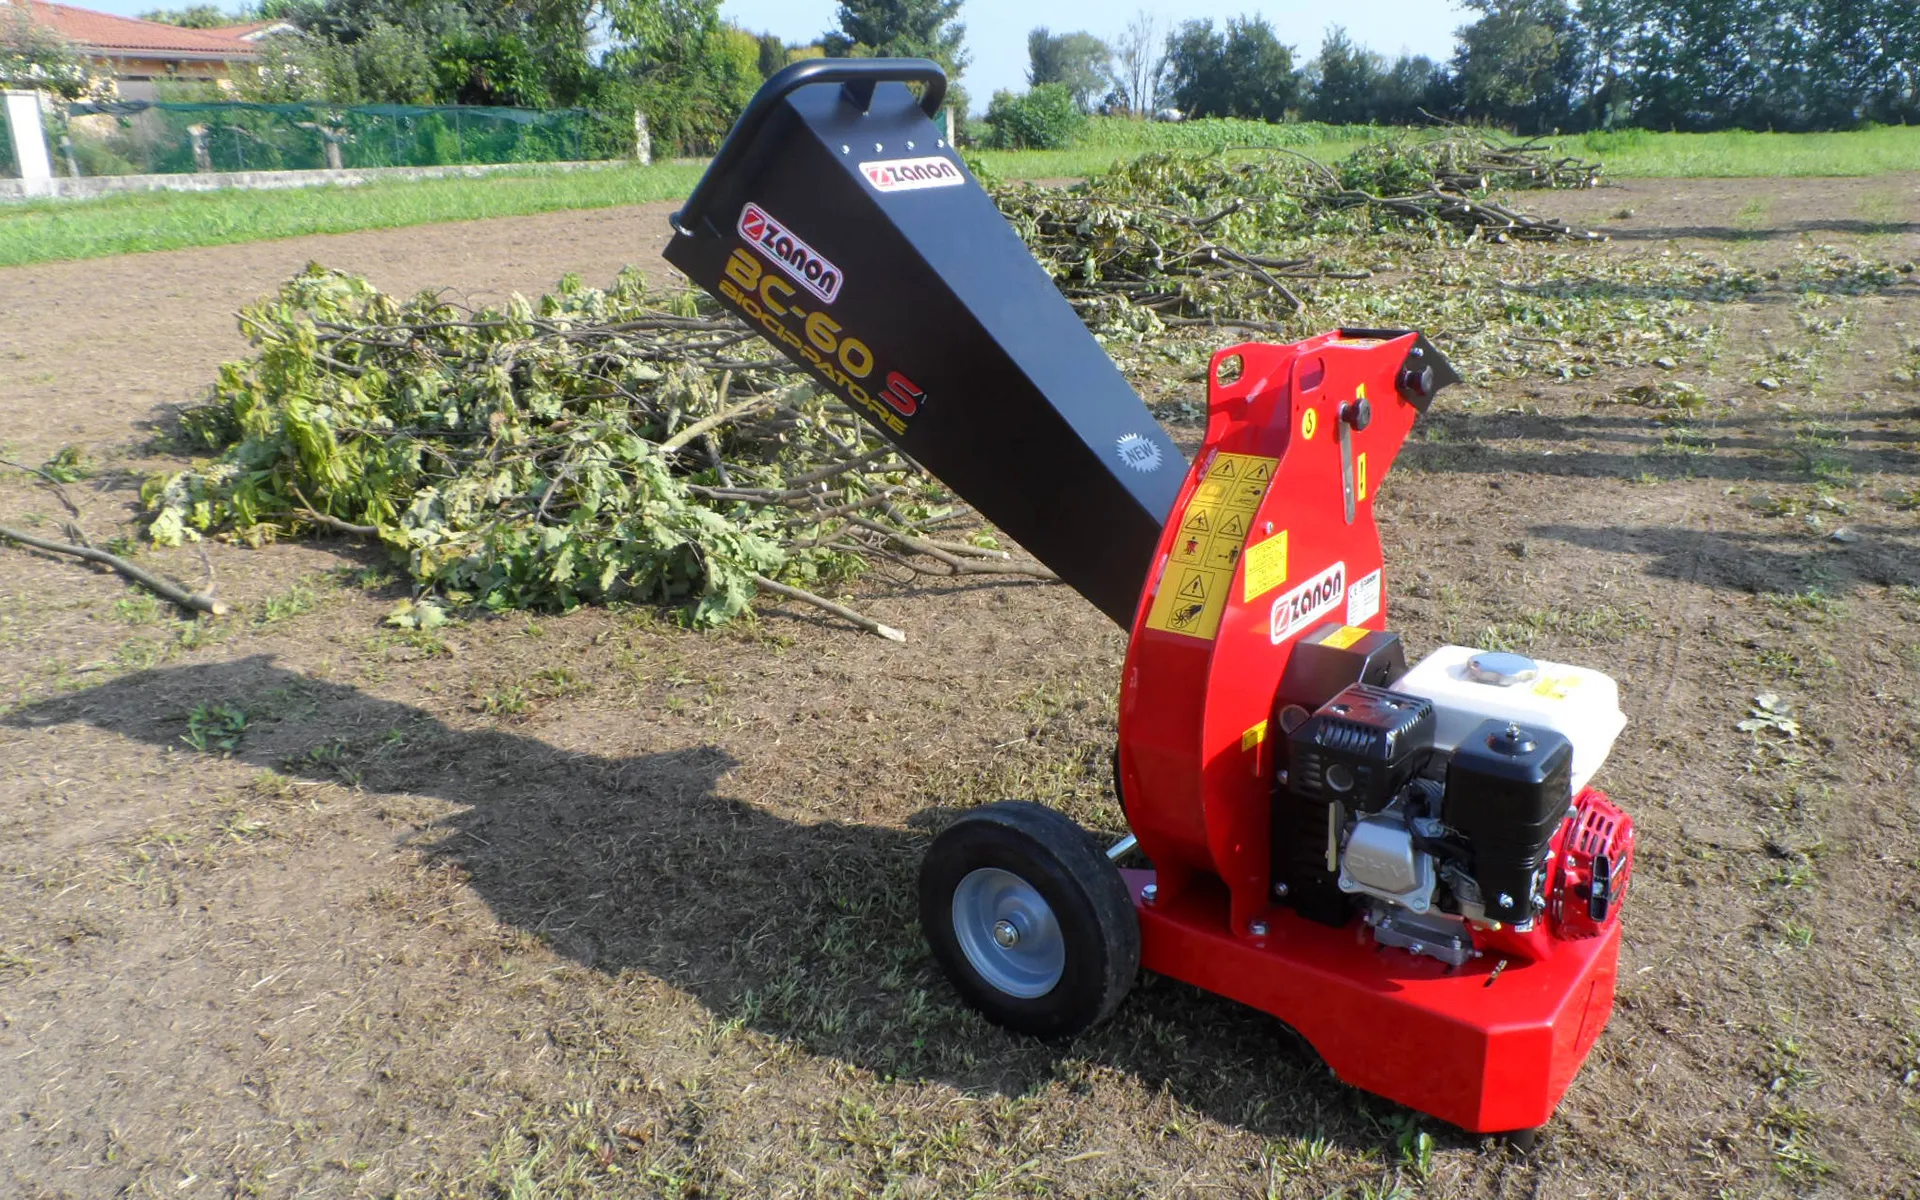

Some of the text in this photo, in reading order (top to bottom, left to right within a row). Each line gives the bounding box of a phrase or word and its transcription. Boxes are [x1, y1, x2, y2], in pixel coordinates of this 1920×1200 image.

[718, 279, 908, 436] BIOCIPPATORE
[725, 247, 924, 417] BC-60 S
[1124, 442, 1154, 464] NEW
